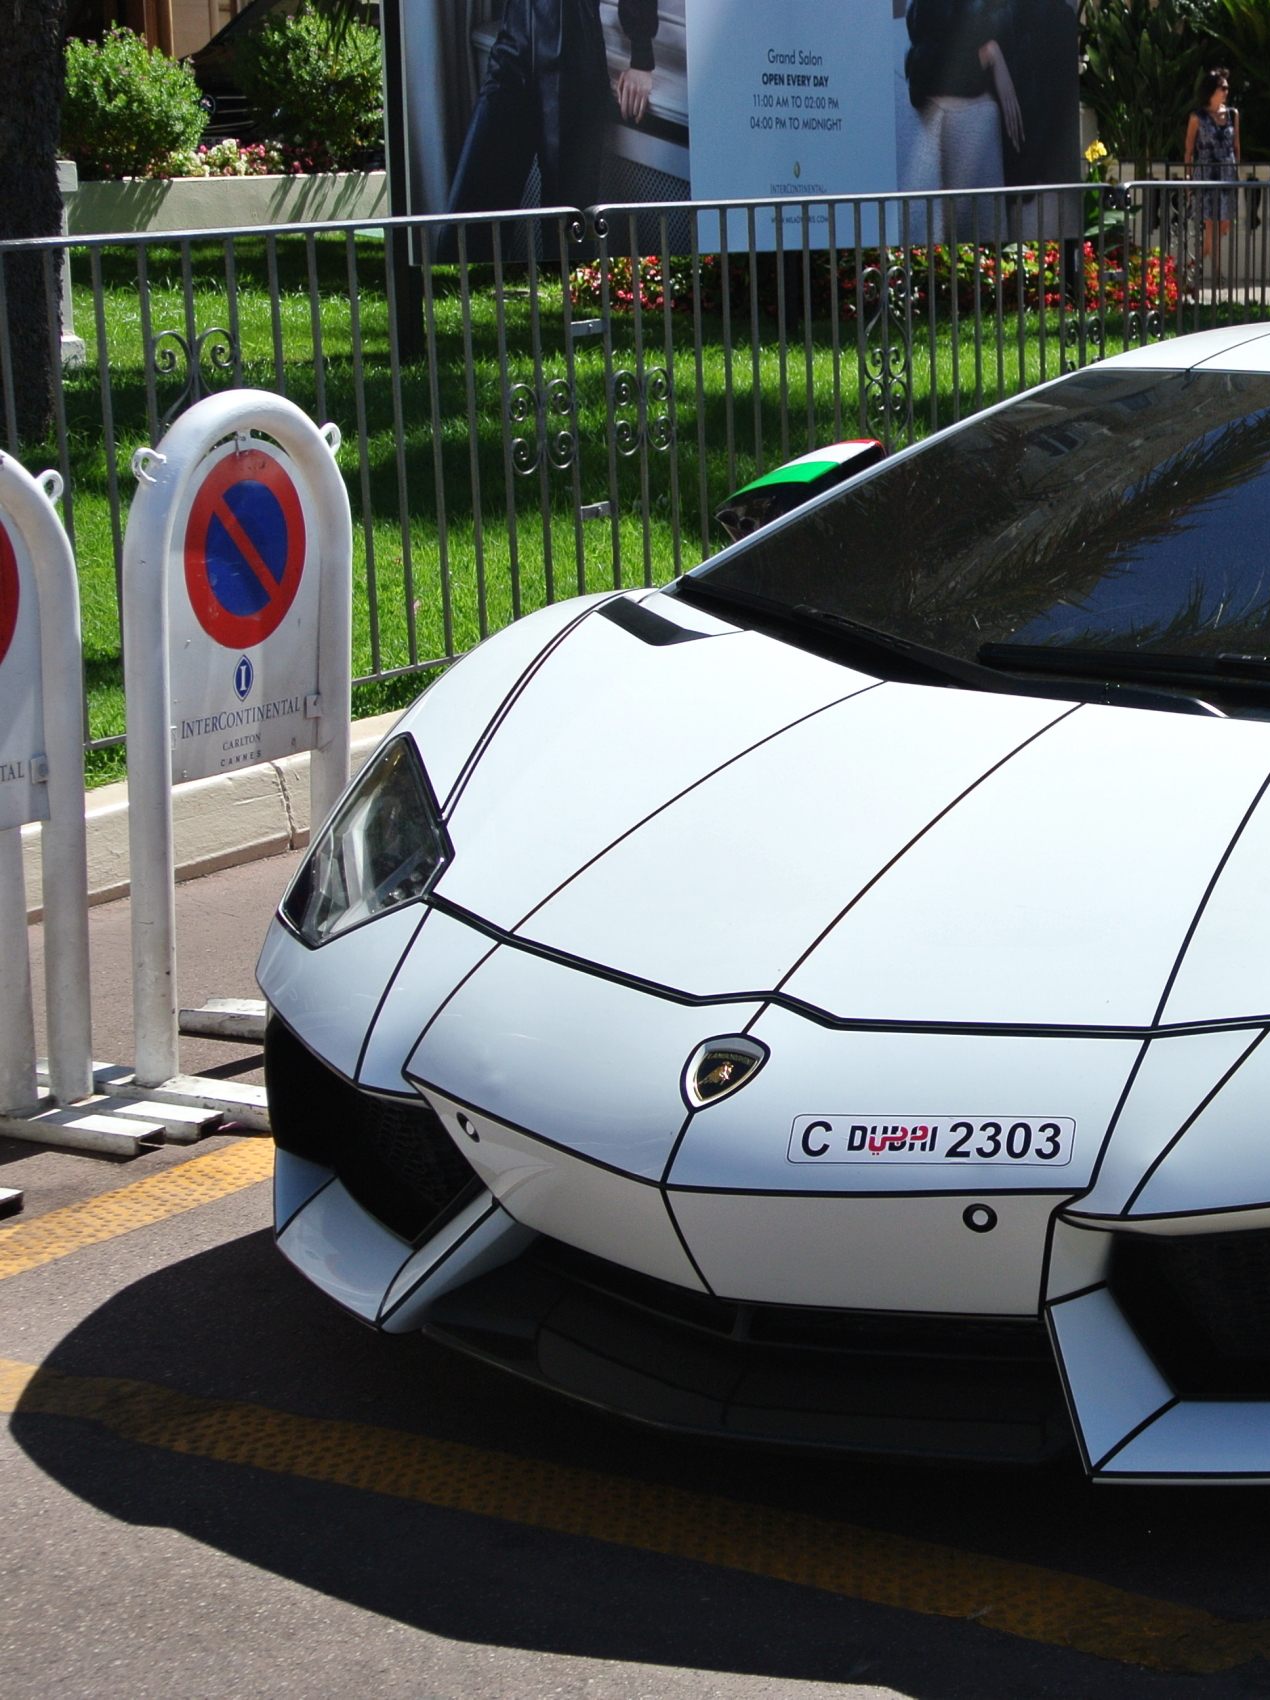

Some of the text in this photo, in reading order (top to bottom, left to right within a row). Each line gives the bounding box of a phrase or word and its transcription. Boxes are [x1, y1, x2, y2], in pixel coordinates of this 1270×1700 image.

[767, 48, 823, 66] Grand Salon
[762, 73, 829, 88] OPEN EVERY DAY
[753, 94, 839, 109] 11:00 AM TO 02:00 PM
[750, 116, 842, 131] 04:00 PM TO MIDNIGHT
[222, 733, 261, 751] CARLTON
[220, 750, 261, 767] CANNES
[801, 1121, 832, 1157] C
[945, 1121, 1062, 1160] 2303
